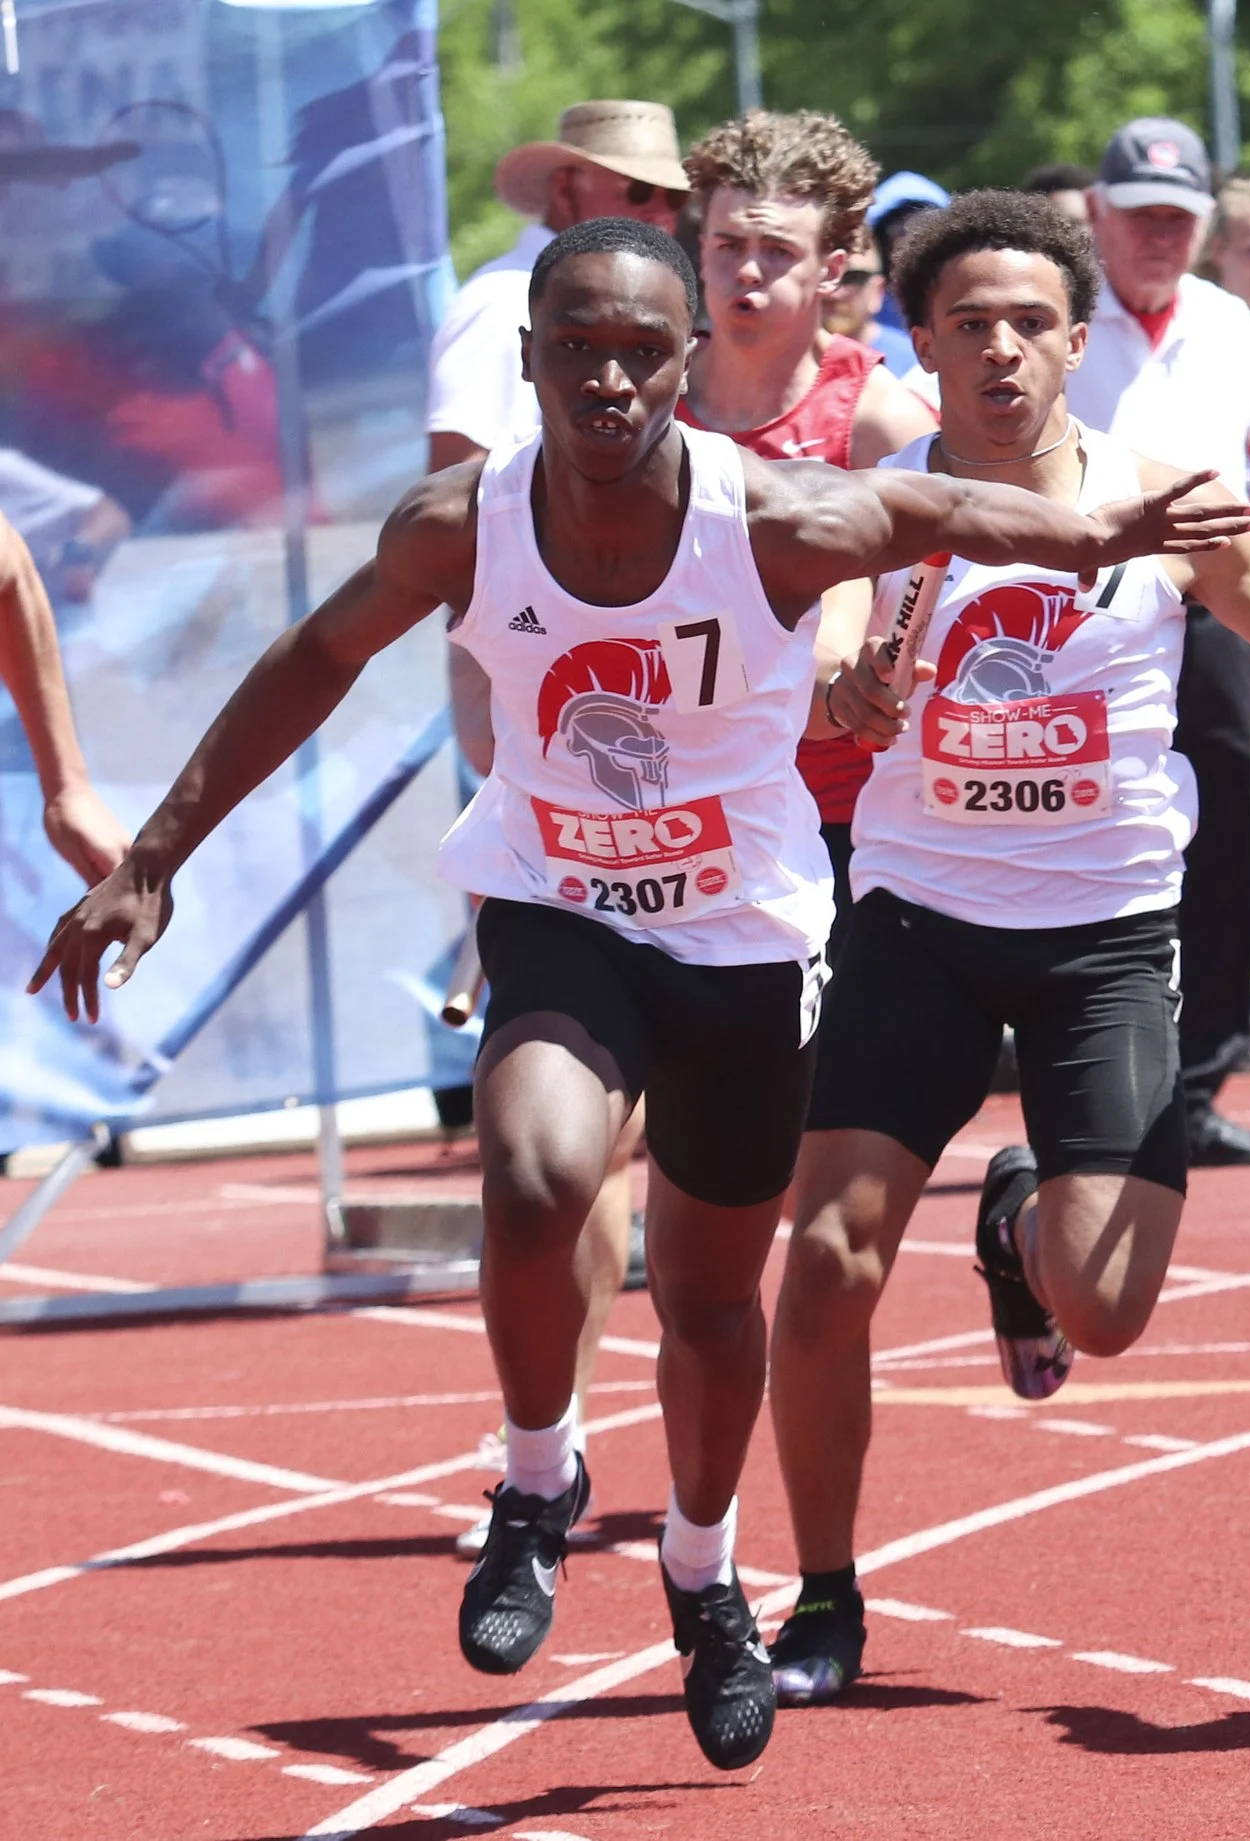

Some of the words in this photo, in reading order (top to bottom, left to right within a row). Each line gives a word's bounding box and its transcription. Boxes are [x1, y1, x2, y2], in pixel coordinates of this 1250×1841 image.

[896, 576, 924, 630] HILL
[508, 622, 547, 635] adidas
[674, 618, 721, 706] 7
[938, 714, 1087, 758] ZERO
[970, 705, 1052, 723] SHOW-ME
[964, 780, 1066, 812] 2306
[549, 810, 703, 859] ZERO
[590, 872, 687, 916] 2307
